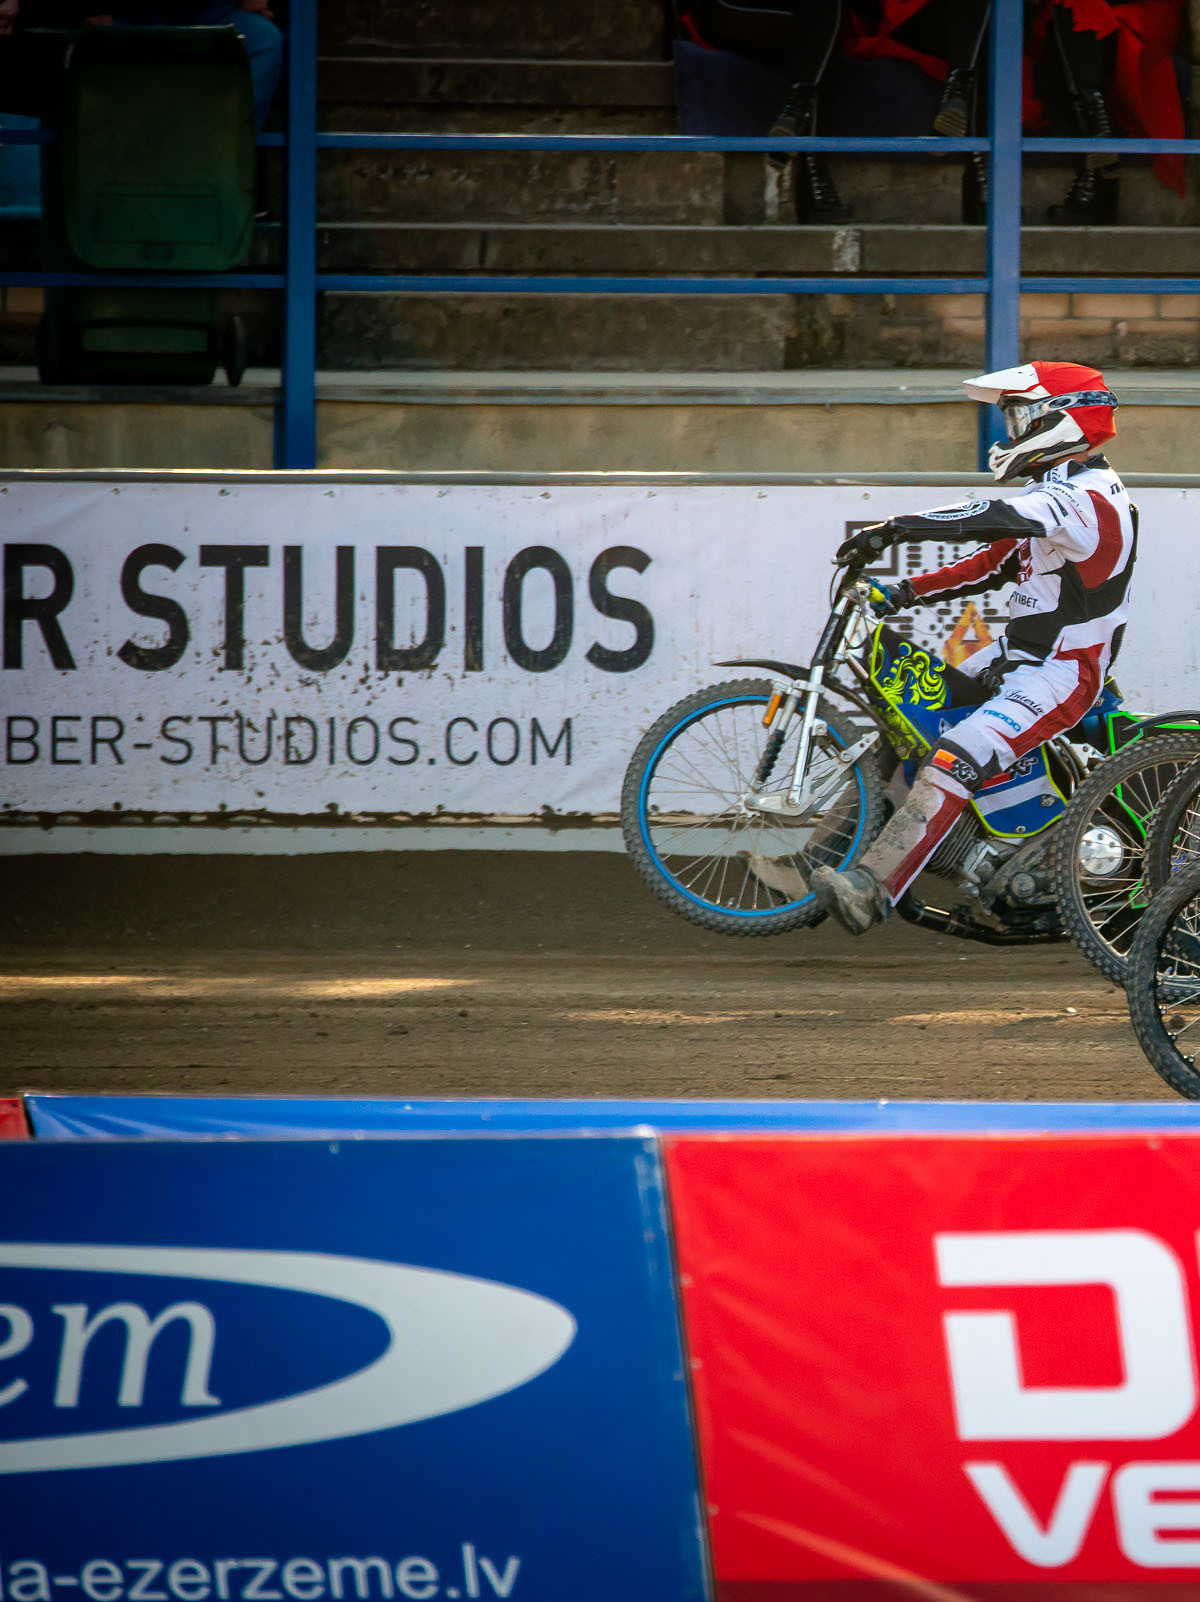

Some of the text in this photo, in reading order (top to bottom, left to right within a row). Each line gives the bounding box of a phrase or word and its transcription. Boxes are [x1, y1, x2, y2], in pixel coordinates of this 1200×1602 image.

[3, 543, 655, 673] R STUDIOS
[983, 709, 1022, 732] TRODO
